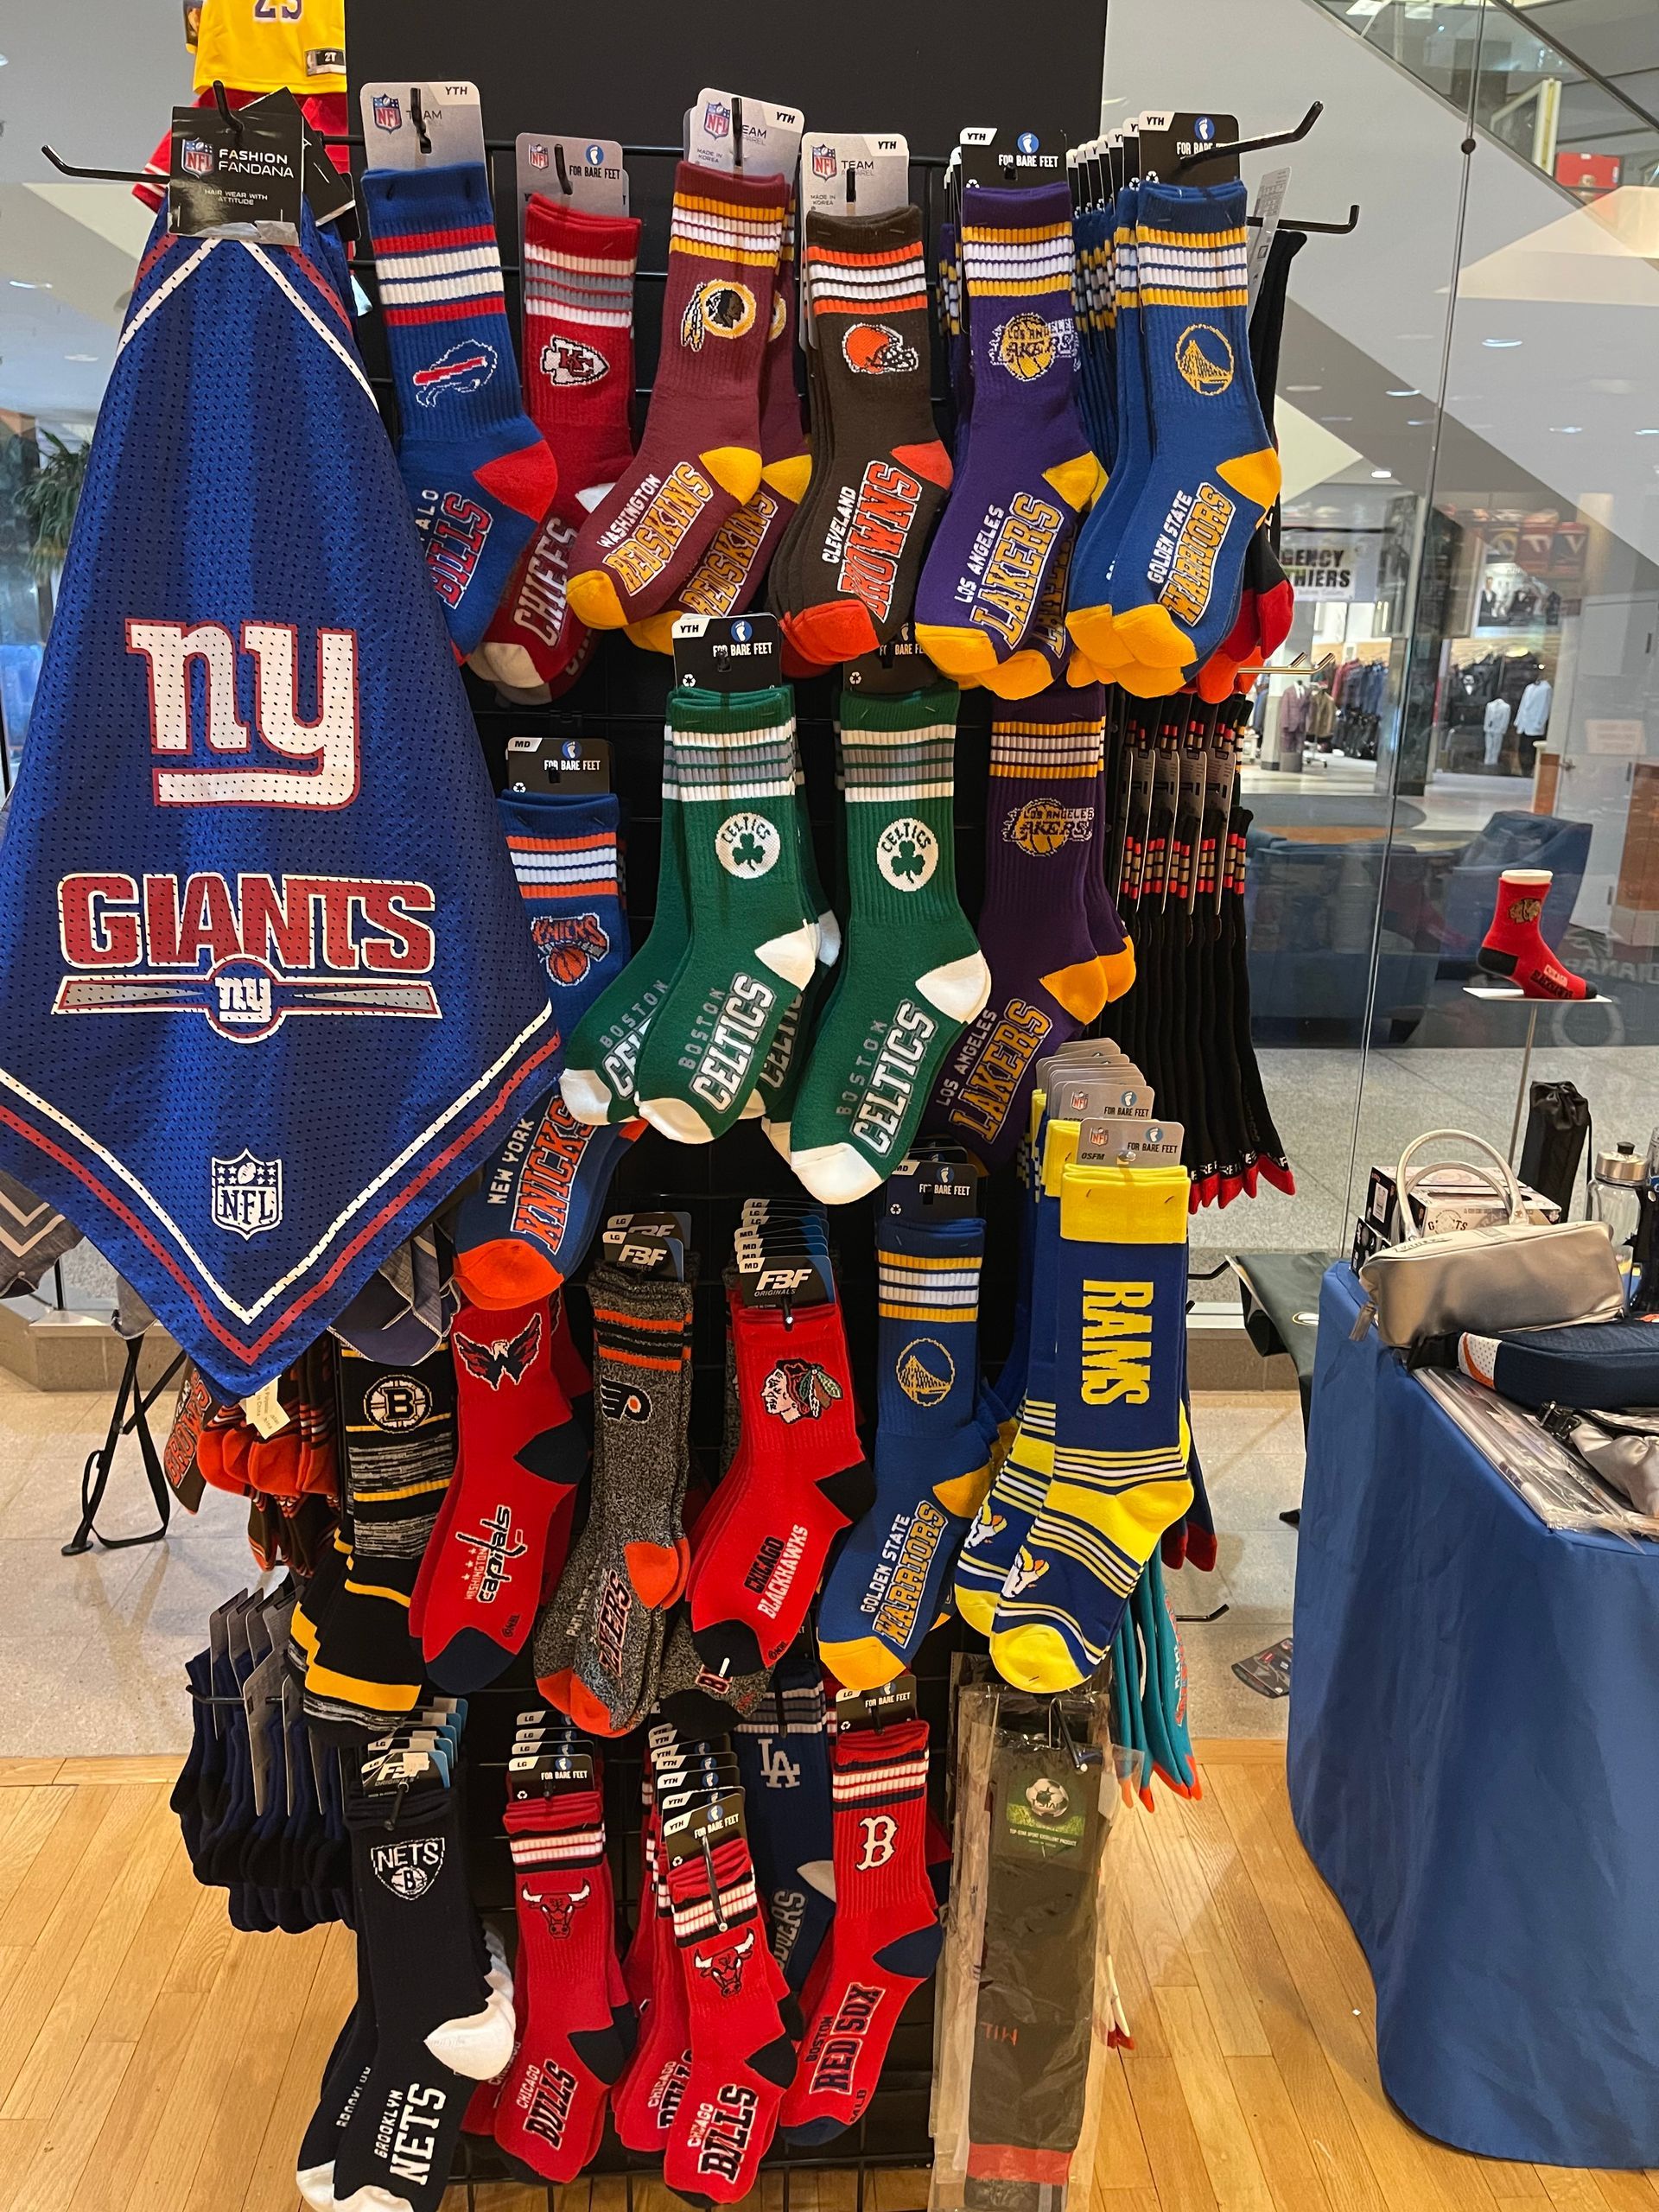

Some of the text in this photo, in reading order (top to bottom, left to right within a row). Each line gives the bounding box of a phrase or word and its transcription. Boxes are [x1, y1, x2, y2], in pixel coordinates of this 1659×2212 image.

[446, 86, 468, 96] YTH
[377, 106, 401, 127] NFL
[406, 110, 442, 120] TAM
[706, 112, 729, 136] NFL
[776, 111, 795, 124] YTH
[1147, 117, 1166, 126] YTH
[741, 124, 767, 139] EAM
[966, 131, 987, 142] YTH
[696, 149, 714, 157] MADE
[878, 140, 898, 150] YTH
[1176, 142, 1192, 156] FOR
[186, 150, 213, 171] NFL
[219, 149, 289, 165] FASHION
[531, 154, 550, 169] NFL
[698, 154, 720, 164] KOREA
[814, 156, 837, 175] NFL
[841, 160, 875, 170] TEAM
[998, 153, 1014, 166] FOR
[1016, 155, 1038, 167] BARE
[1039, 155, 1058, 168] FEET
[219, 161, 295, 179] FANDANA
[569, 165, 621, 181] FOR BARE FEET
[218, 197, 254, 206] ATTITUDE
[596, 474, 661, 549] WASHINGTON
[601, 461, 715, 597] REDSKINS
[821, 486, 857, 564] CLEVELAND
[837, 460, 923, 624] BROWNS
[1147, 489, 1193, 584] GOLDEN STATE
[954, 504, 1005, 604] LOS ANGELES
[1157, 481, 1236, 627] WARRIORS
[1281, 549, 1345, 568] GENCY
[969, 492, 1065, 652] LAKERS
[680, 624, 700, 633] YTH
[730, 643, 751, 657] BARE
[753, 641, 772, 655] FEET
[895, 643, 913, 656] BARE
[514, 740, 531, 748] MD
[561, 760, 580, 771] BARE
[582, 760, 601, 771] FEET
[1023, 810, 1043, 819] LOS
[721, 816, 772, 844] CELTICS
[880, 822, 932, 854] CELTICS
[57, 872, 435, 974] GIANTS
[600, 978, 670, 1050] BOSTON
[678, 987, 726, 1071] BOSTON
[688, 972, 778, 1114] CELTICS
[936, 1008, 997, 1106] LOS ANGELES
[836, 1020, 888, 1116] BOSTON
[849, 998, 939, 1157] CELTICS
[950, 998, 1053, 1144] LAKERS
[1071, 1097, 1088, 1109] NFL
[1103, 1106, 1149, 1118] FOR BARE FEET
[1092, 1129, 1109, 1146] NFL
[1127, 1142, 1178, 1154] FOR BARE FEET
[487, 1117, 535, 1204] NEW YORK
[934, 1185, 952, 1195] BARE
[954, 1185, 970, 1196] FEET
[220, 1189, 274, 1225] NFL
[618, 1244, 668, 1267] FBF
[756, 1268, 813, 1291] FBF
[753, 1288, 796, 1298] ORIGINALS
[1081, 1278, 1154, 1406] RAMS
[744, 1535, 786, 1595] CHICAGO
[757, 1523, 809, 1620] BLACKHAWKS
[861, 1513, 911, 1615] GOLDEN STATE
[872, 1500, 949, 1649] WARRIORS
[865, 1692, 912, 1708] FOR BARE FEET
[655, 1736, 669, 1745] YTH
[758, 1738, 801, 1789] LA
[573, 1770, 588, 1779] FEET
[670, 1821, 684, 1831] YTH
[708, 1821, 724, 1834] BARE
[724, 1813, 740, 1827] FEET
[854, 1814, 899, 1872] B
[378, 1841, 439, 1872] NETS
[403, 1872, 416, 1891] B
[516, 2064, 541, 2110] CHICAGO
[647, 2061, 677, 2108] CHICAGO
[523, 2058, 579, 2151] BULLS
[374, 2089, 404, 2159] BROOKLYN
[389, 2082, 447, 2186] NETS
[687, 2101, 715, 2149] CHICAGO
[697, 2083, 759, 2184] BULLS
